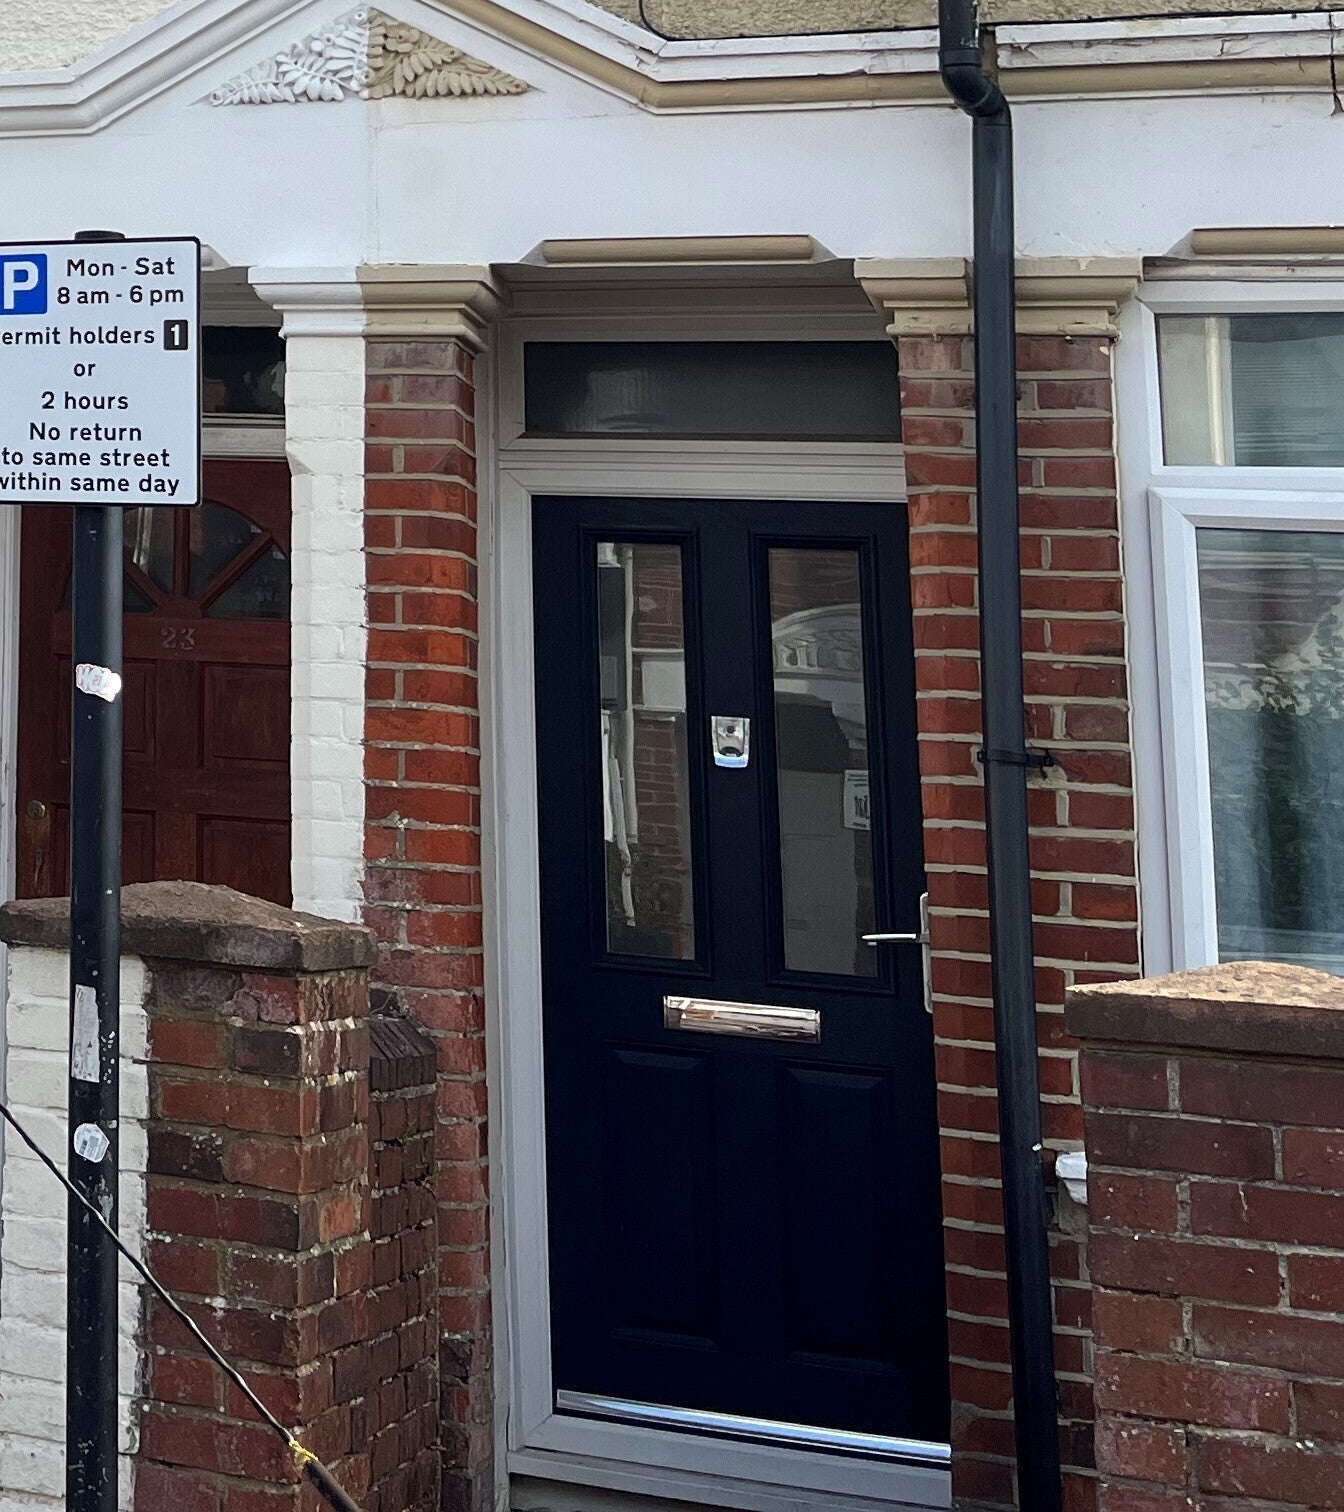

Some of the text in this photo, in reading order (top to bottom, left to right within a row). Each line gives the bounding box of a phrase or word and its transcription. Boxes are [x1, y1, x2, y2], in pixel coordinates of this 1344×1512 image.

[66, 258, 115, 277] Mon
[134, 256, 175, 276] Sat
[3, 261, 40, 310] P
[56, 286, 71, 305] 8
[76, 290, 110, 305] am
[129, 284, 143, 304] 6
[149, 289, 184, 307] pm
[69, 325, 155, 345] holders
[170, 323, 180, 346] 1
[73, 362, 96, 378] or
[41, 390, 129, 410] 2 hours
[29, 421, 142, 442] No return
[1, 446, 170, 468] to same street
[69, 477, 130, 492] same
[138, 473, 180, 497] day
[161, 627, 196, 651] 23
